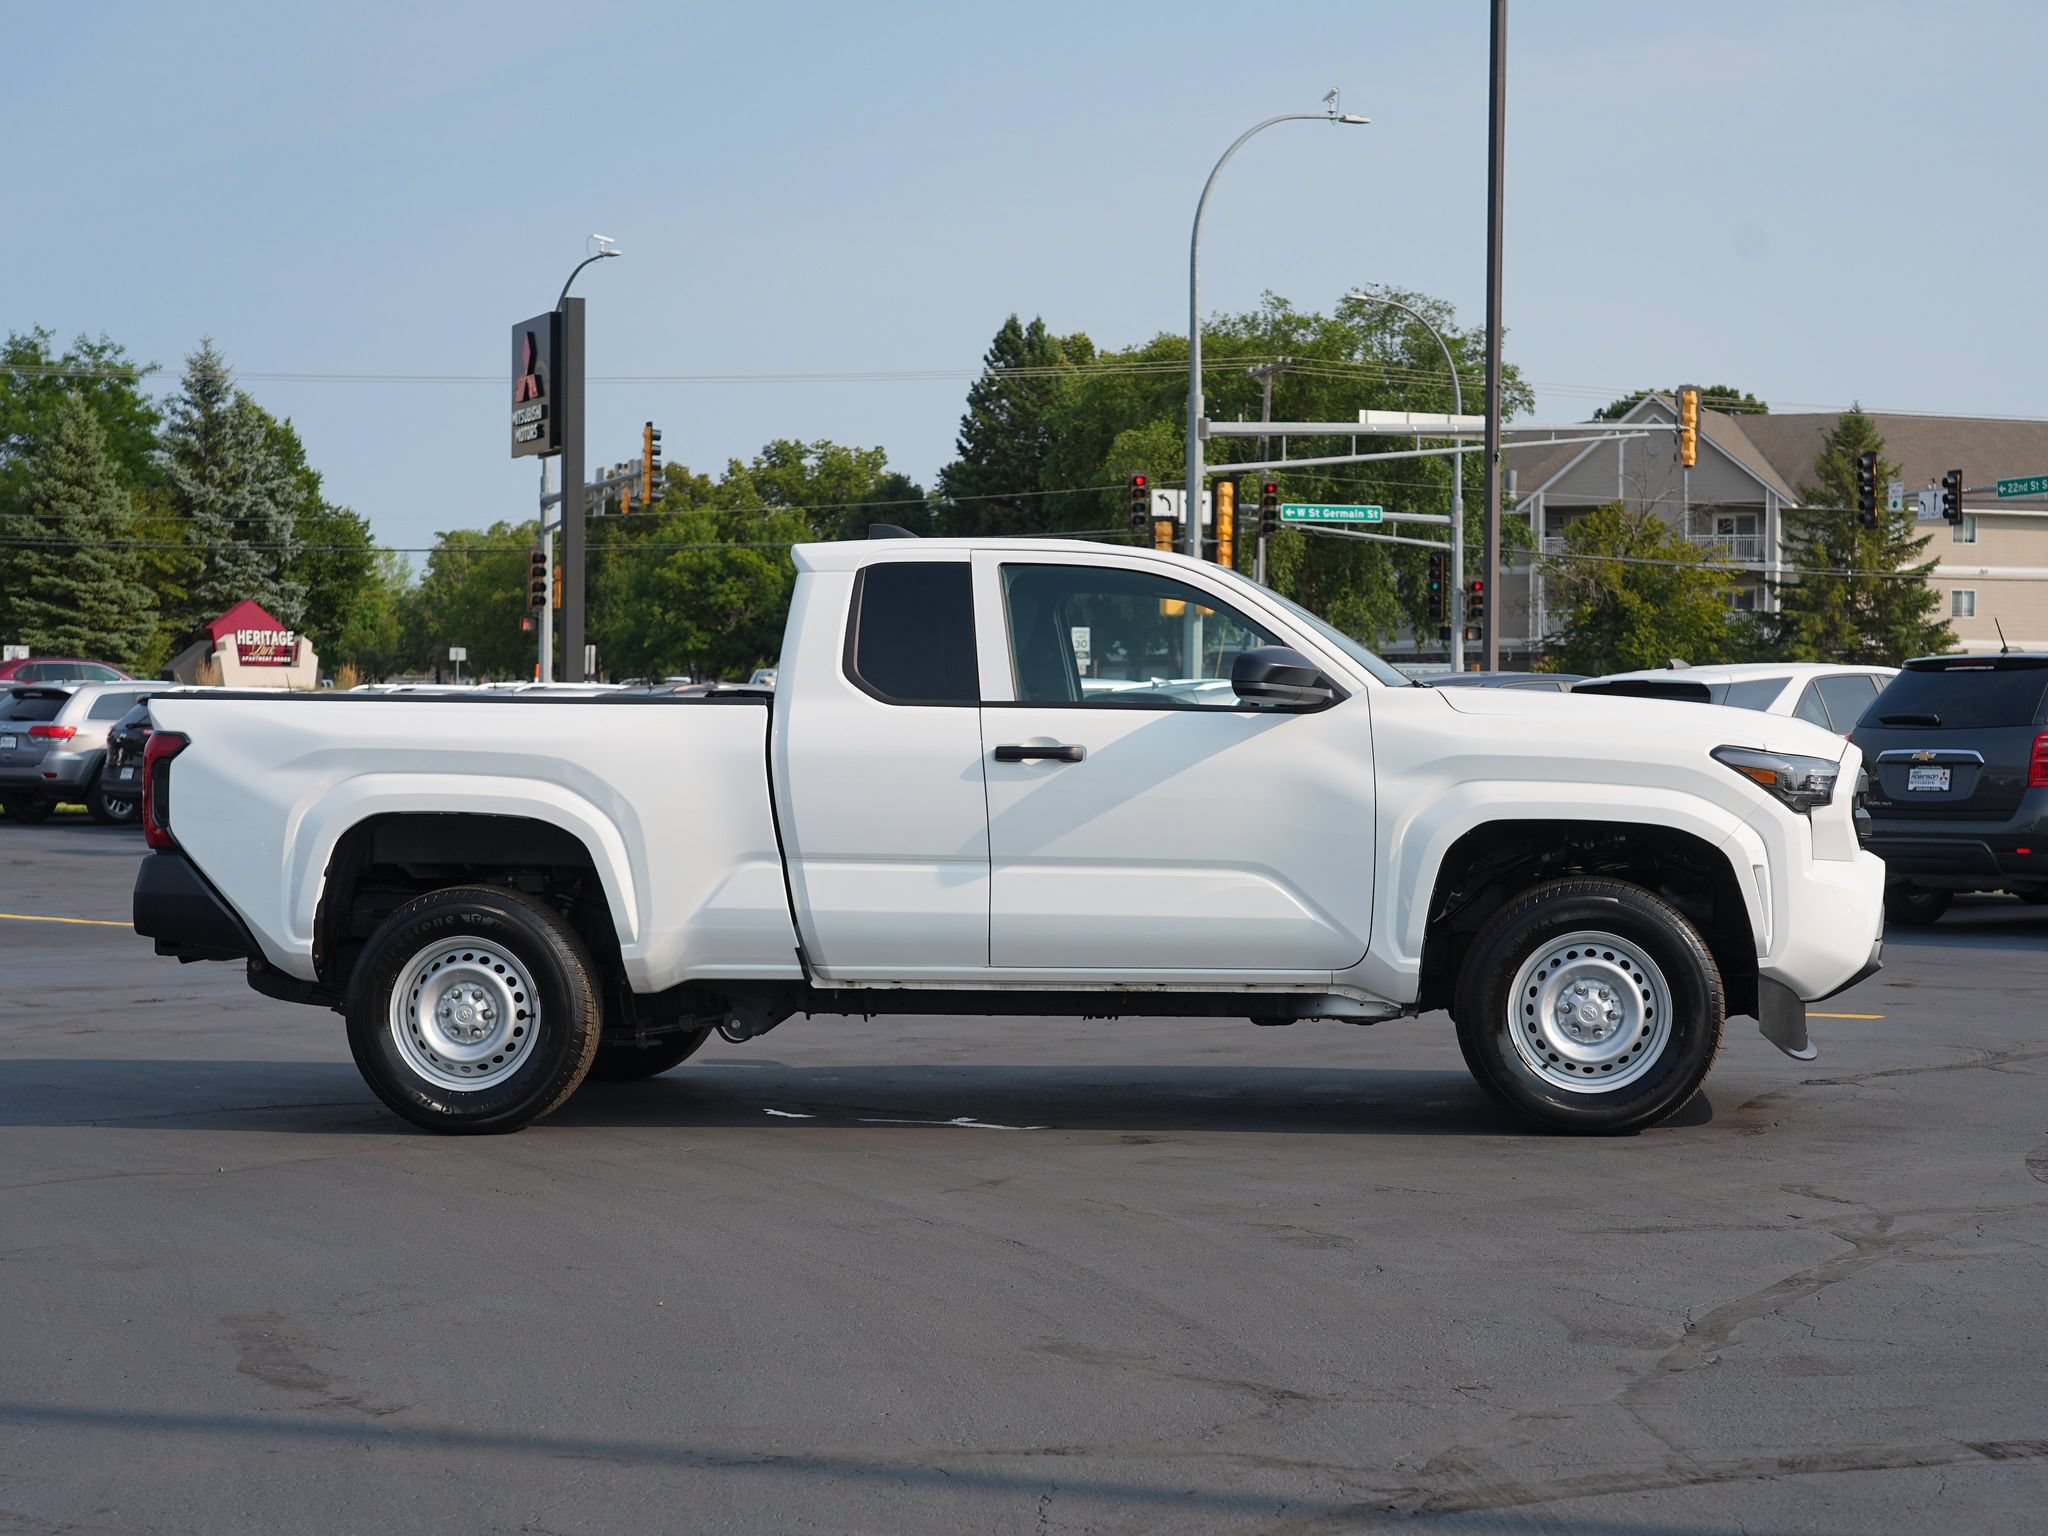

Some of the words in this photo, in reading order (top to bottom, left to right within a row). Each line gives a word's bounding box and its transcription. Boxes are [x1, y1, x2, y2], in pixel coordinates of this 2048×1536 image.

[515, 423, 538, 442] MOTORS
[2007, 482, 2028, 493] 22nd
[2030, 480, 2040, 491] St
[1297, 508, 1306, 518] W
[1308, 508, 1320, 518] St
[1323, 508, 1364, 518] Germain
[1367, 509, 1379, 519] St
[237, 629, 295, 646] HERITAGE
[1075, 639, 1088, 649] 30
